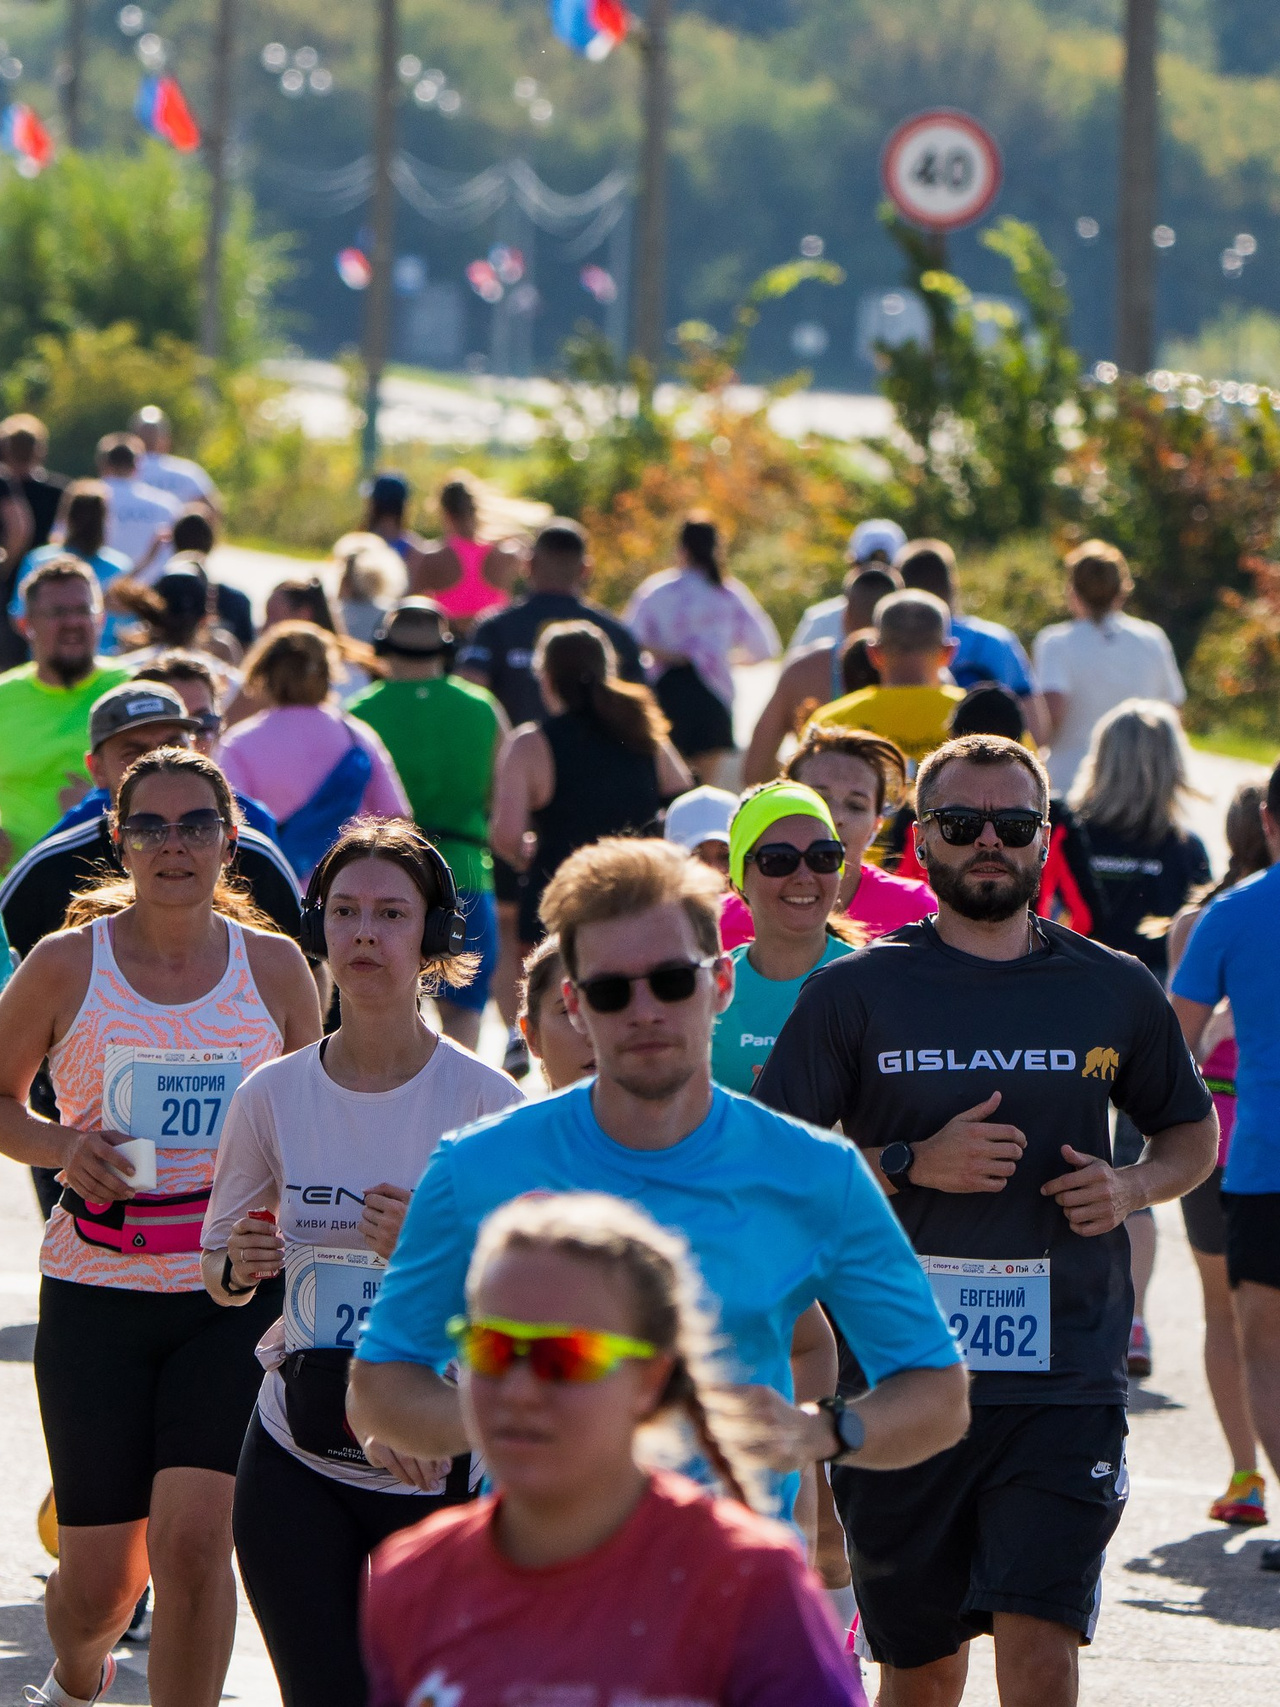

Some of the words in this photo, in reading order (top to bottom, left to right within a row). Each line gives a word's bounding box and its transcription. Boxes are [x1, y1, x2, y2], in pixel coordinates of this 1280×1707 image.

[909, 147, 975, 194] 40
[740, 1033, 777, 1047] Pan
[877, 1049, 1077, 1074] GISLAVED
[157, 1075, 225, 1092] ВИКТОРИЯ
[161, 1098, 222, 1136] 207
[295, 1219, 327, 1229] ЖИВИ
[330, 1219, 359, 1230] ДВИ
[1015, 1265, 1029, 1273] Пэй
[960, 1287, 1025, 1308] ЕВГЕНИЙ
[949, 1313, 1038, 1357] 2462
